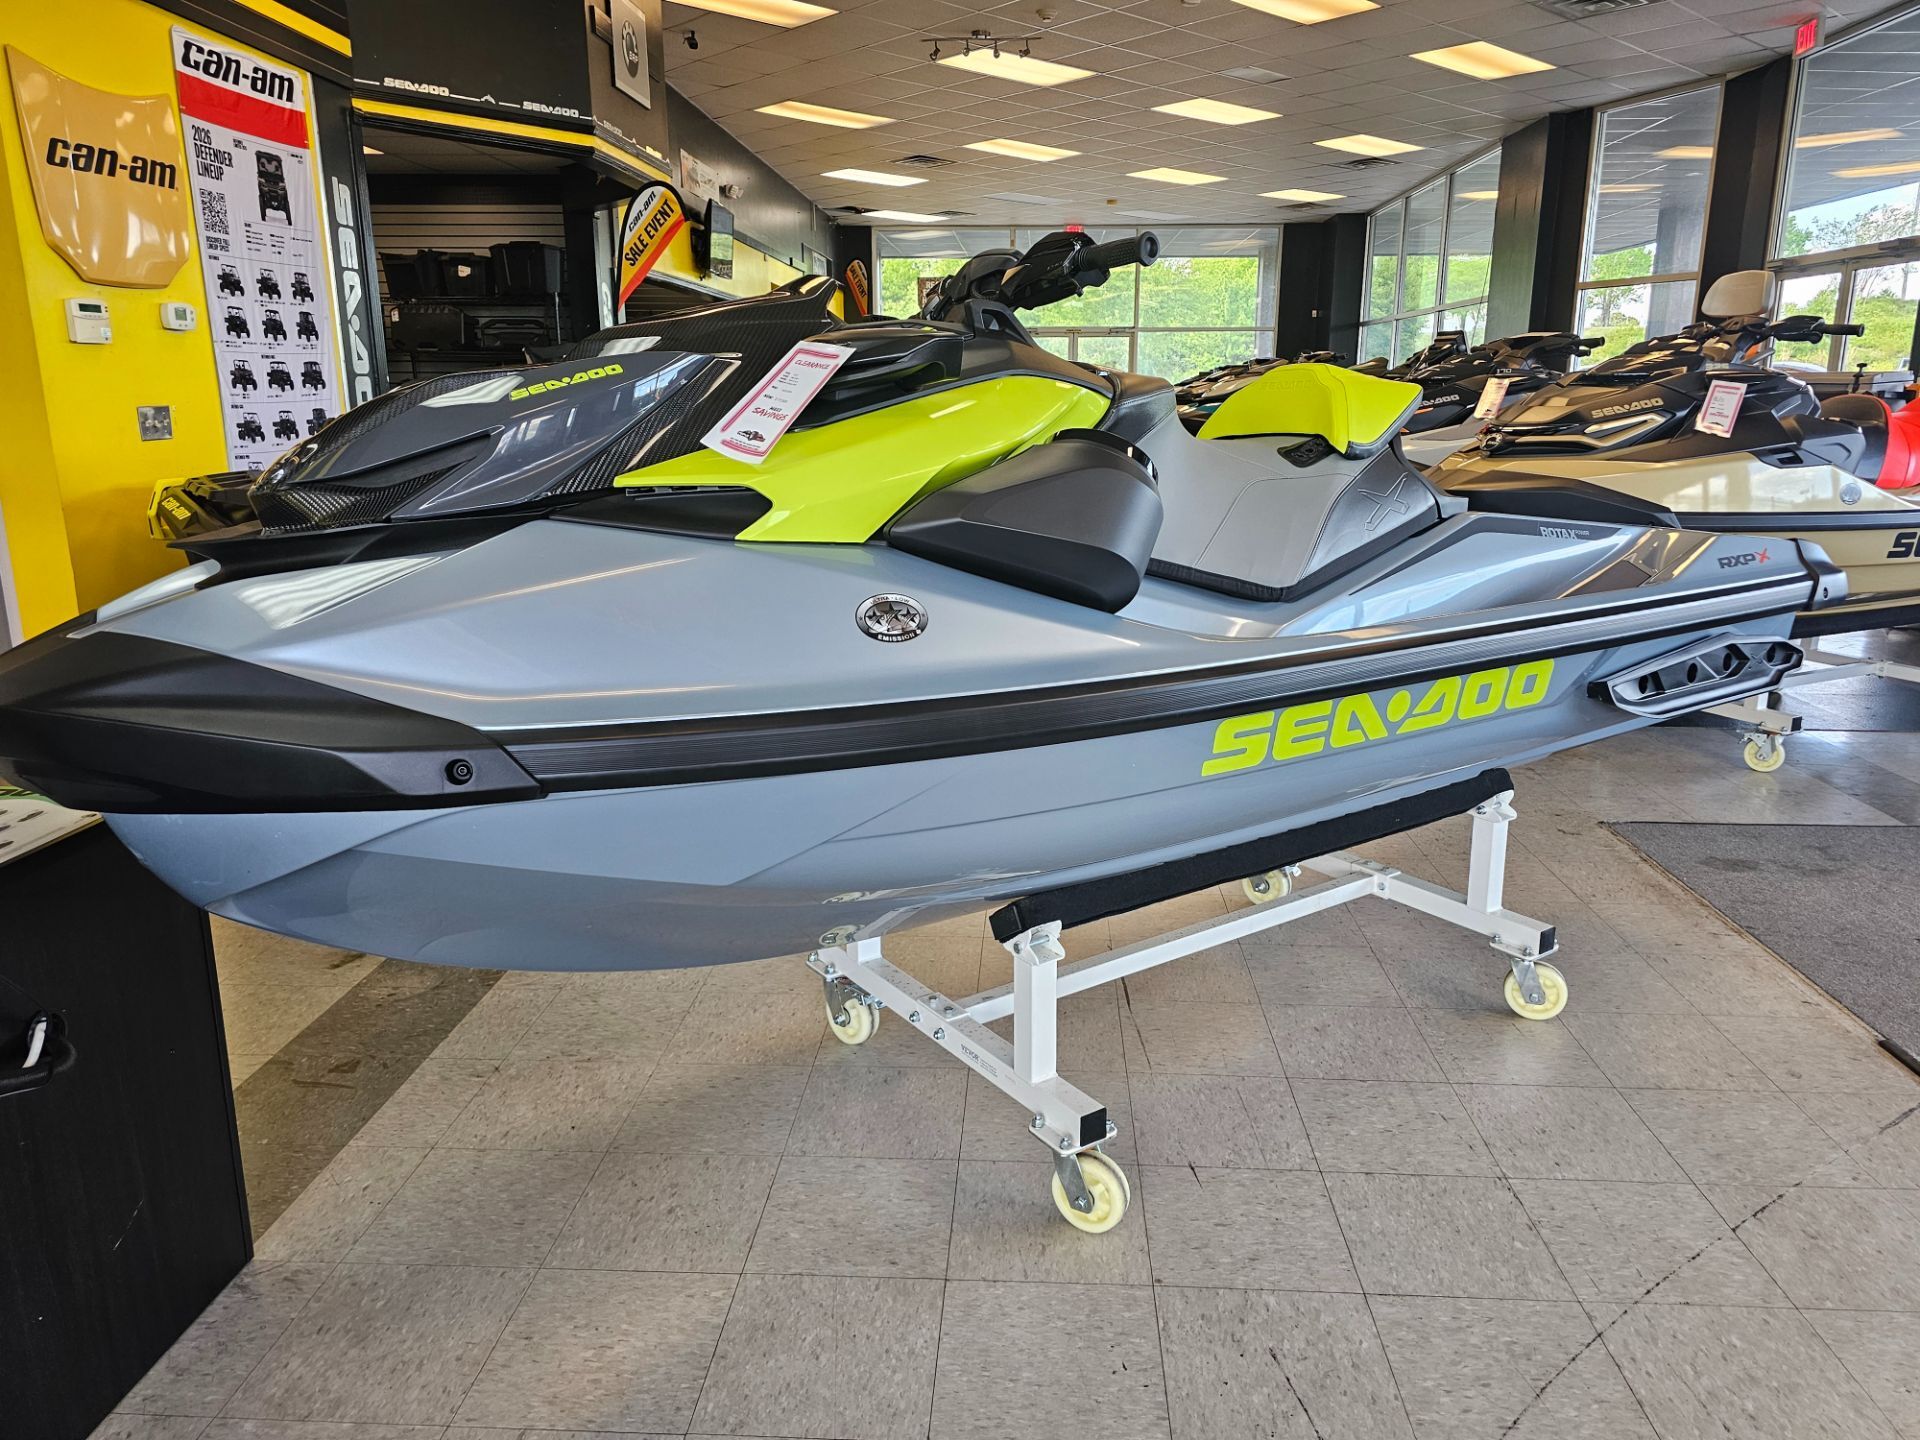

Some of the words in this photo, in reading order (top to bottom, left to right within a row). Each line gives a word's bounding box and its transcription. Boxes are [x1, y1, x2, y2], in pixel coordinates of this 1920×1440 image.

[181, 40, 294, 102] can-am
[192, 125, 212, 146] 2026
[46, 137, 177, 190] can-am
[194, 142, 234, 168] DEFENDER
[196, 160, 225, 181] LINEUP
[628, 191, 657, 232] can-am
[624, 234, 649, 267] SALE
[643, 199, 675, 241] EVENT
[794, 359, 831, 370] CLEARANCE
[752, 407, 788, 421] SAVINGS
[161, 497, 192, 520] can-am
[1540, 526, 1577, 540] ROTAX
[877, 632, 915, 642] EMISSION
